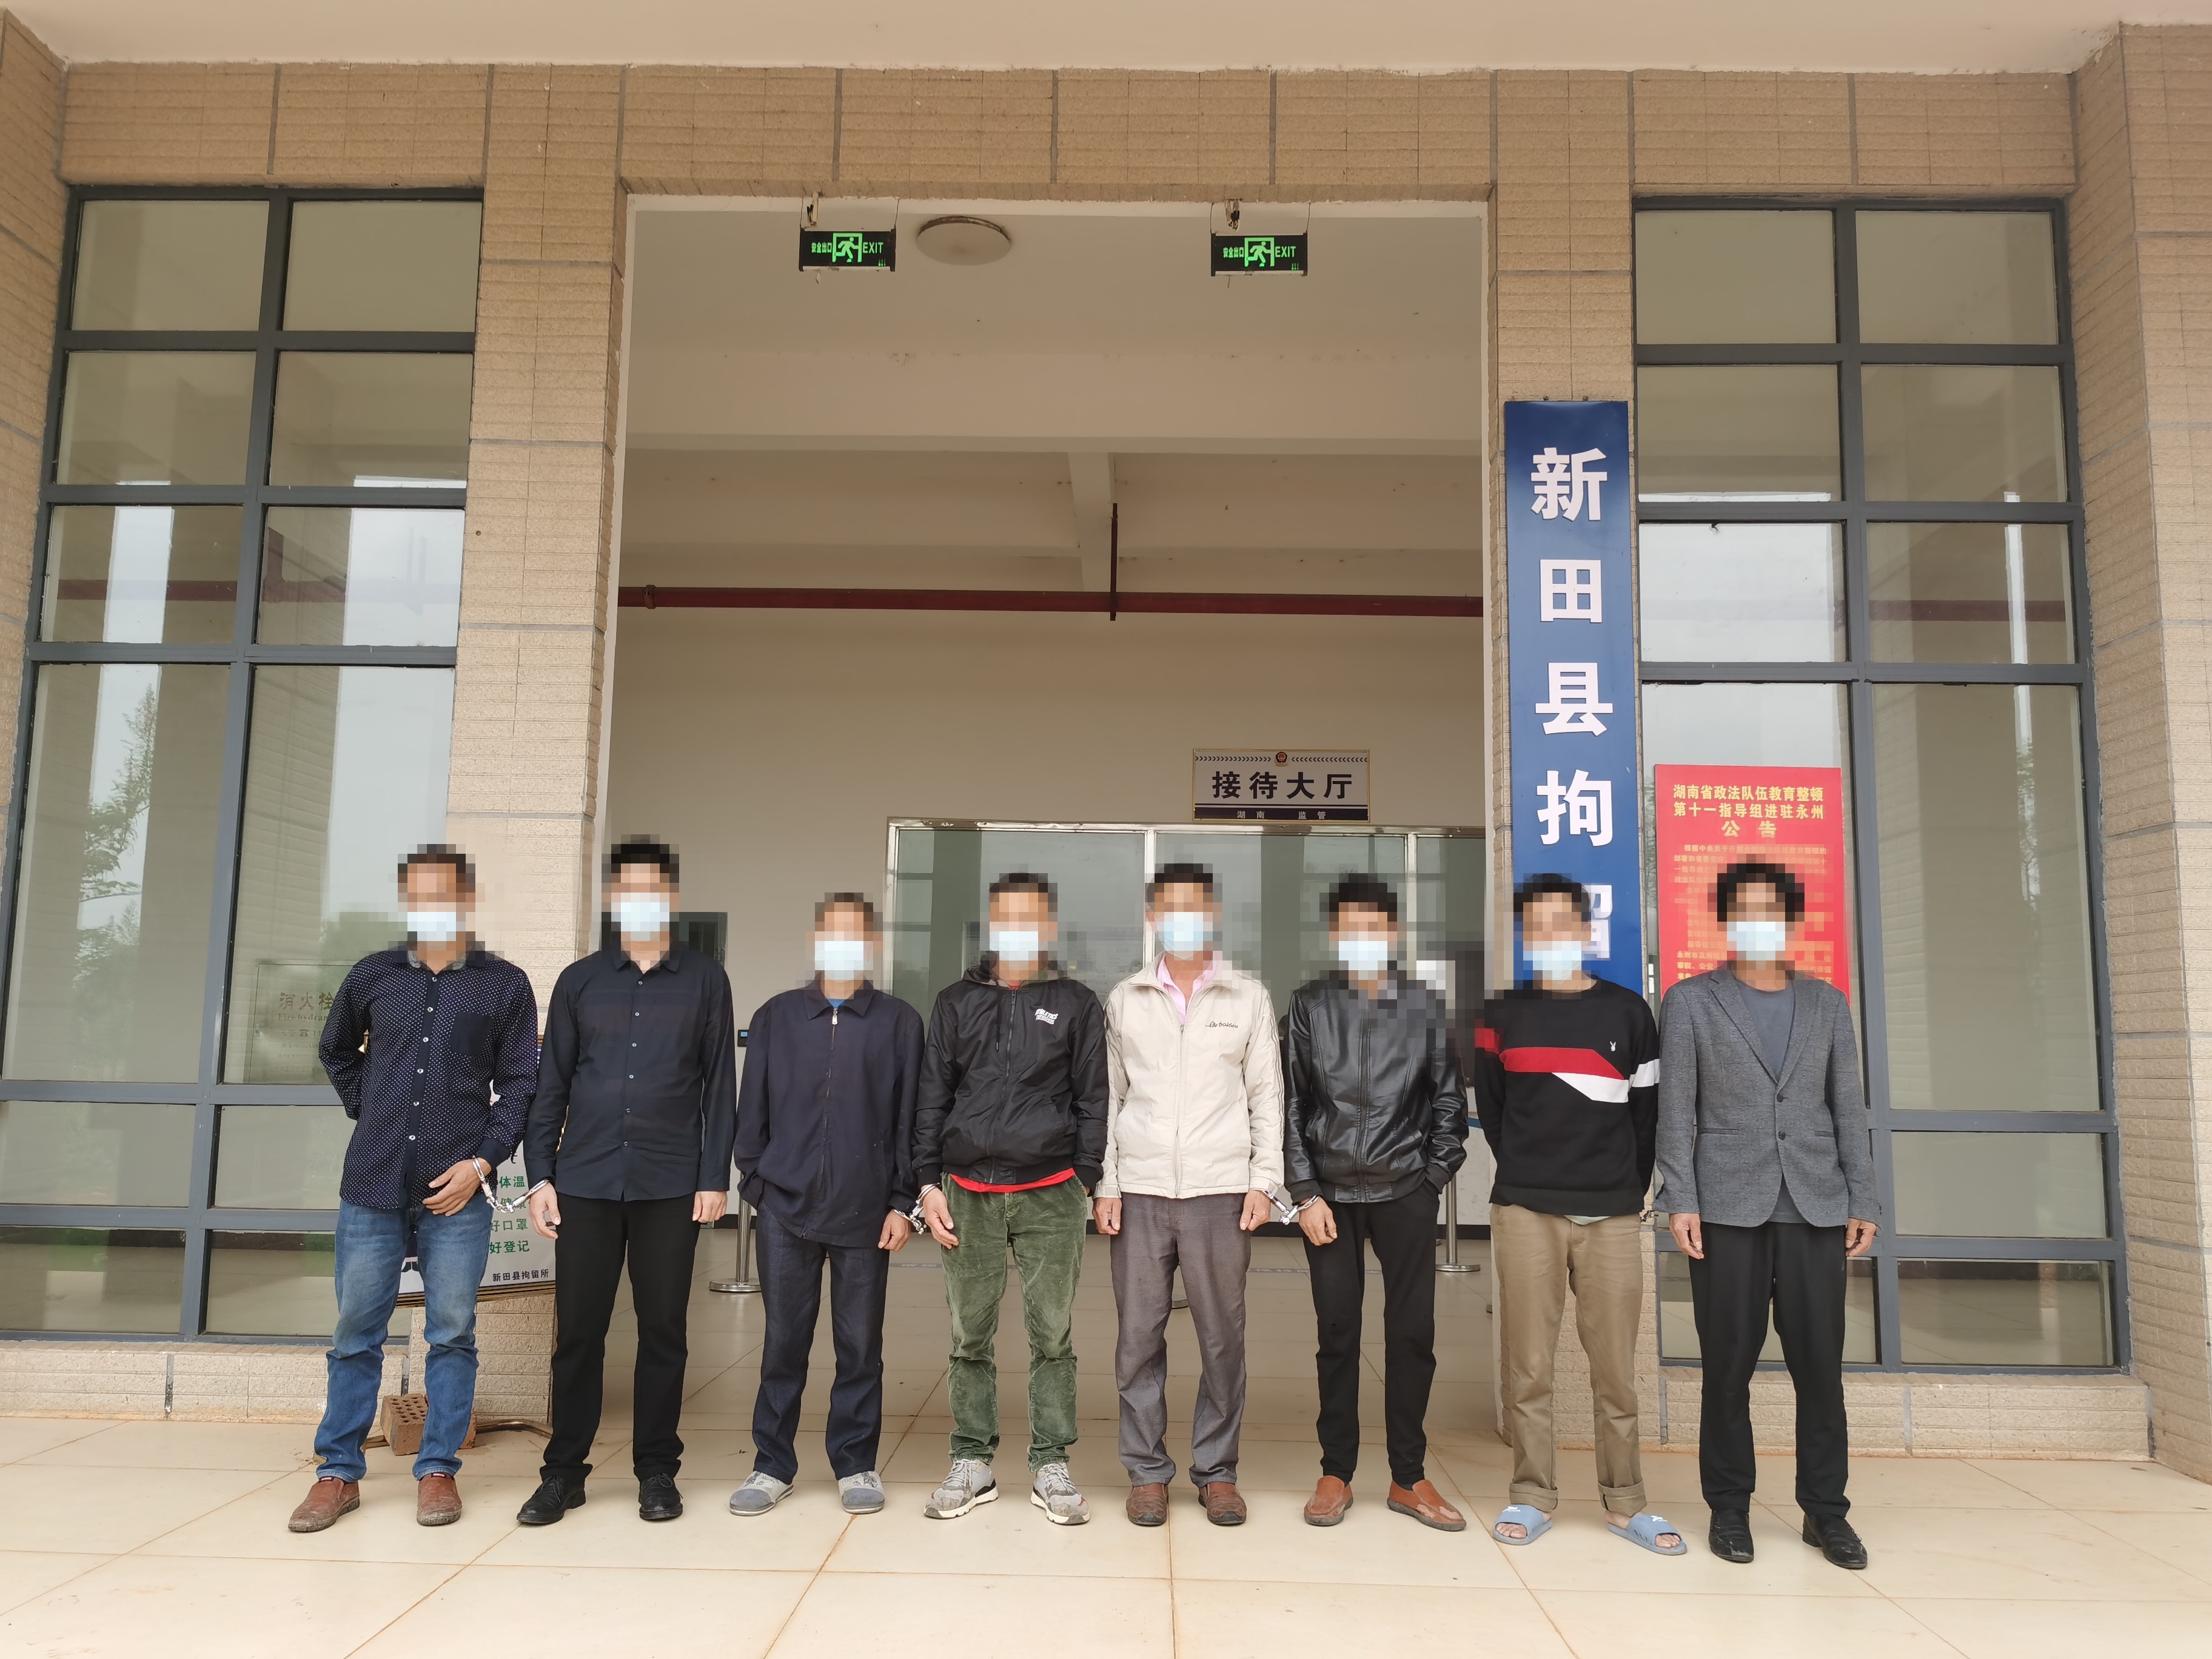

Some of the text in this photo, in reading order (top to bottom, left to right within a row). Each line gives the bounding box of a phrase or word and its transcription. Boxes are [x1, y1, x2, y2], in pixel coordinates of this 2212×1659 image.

[811, 242, 832, 253] 安全出口
[863, 242, 883, 253] EXIT
[1223, 247, 1244, 258] 安全出口
[1275, 246, 1296, 258] EXIT
[1212, 771, 1352, 800] 接待大厅
[1673, 784, 1824, 802] 湖南省政法队伍教育整顿
[1237, 811, 1326, 820] 湖南 监管
[1674, 802, 1824, 819] 第十一指导组进驻永州
[1721, 820, 1777, 838] 公告
[298, 1014, 328, 1022] hydran
[499, 1176, 526, 1188] 体温
[491, 1218, 529, 1232] 好口罩
[489, 1240, 530, 1254] 好登记
[492, 1269, 549, 1282] 新田县拘留所
